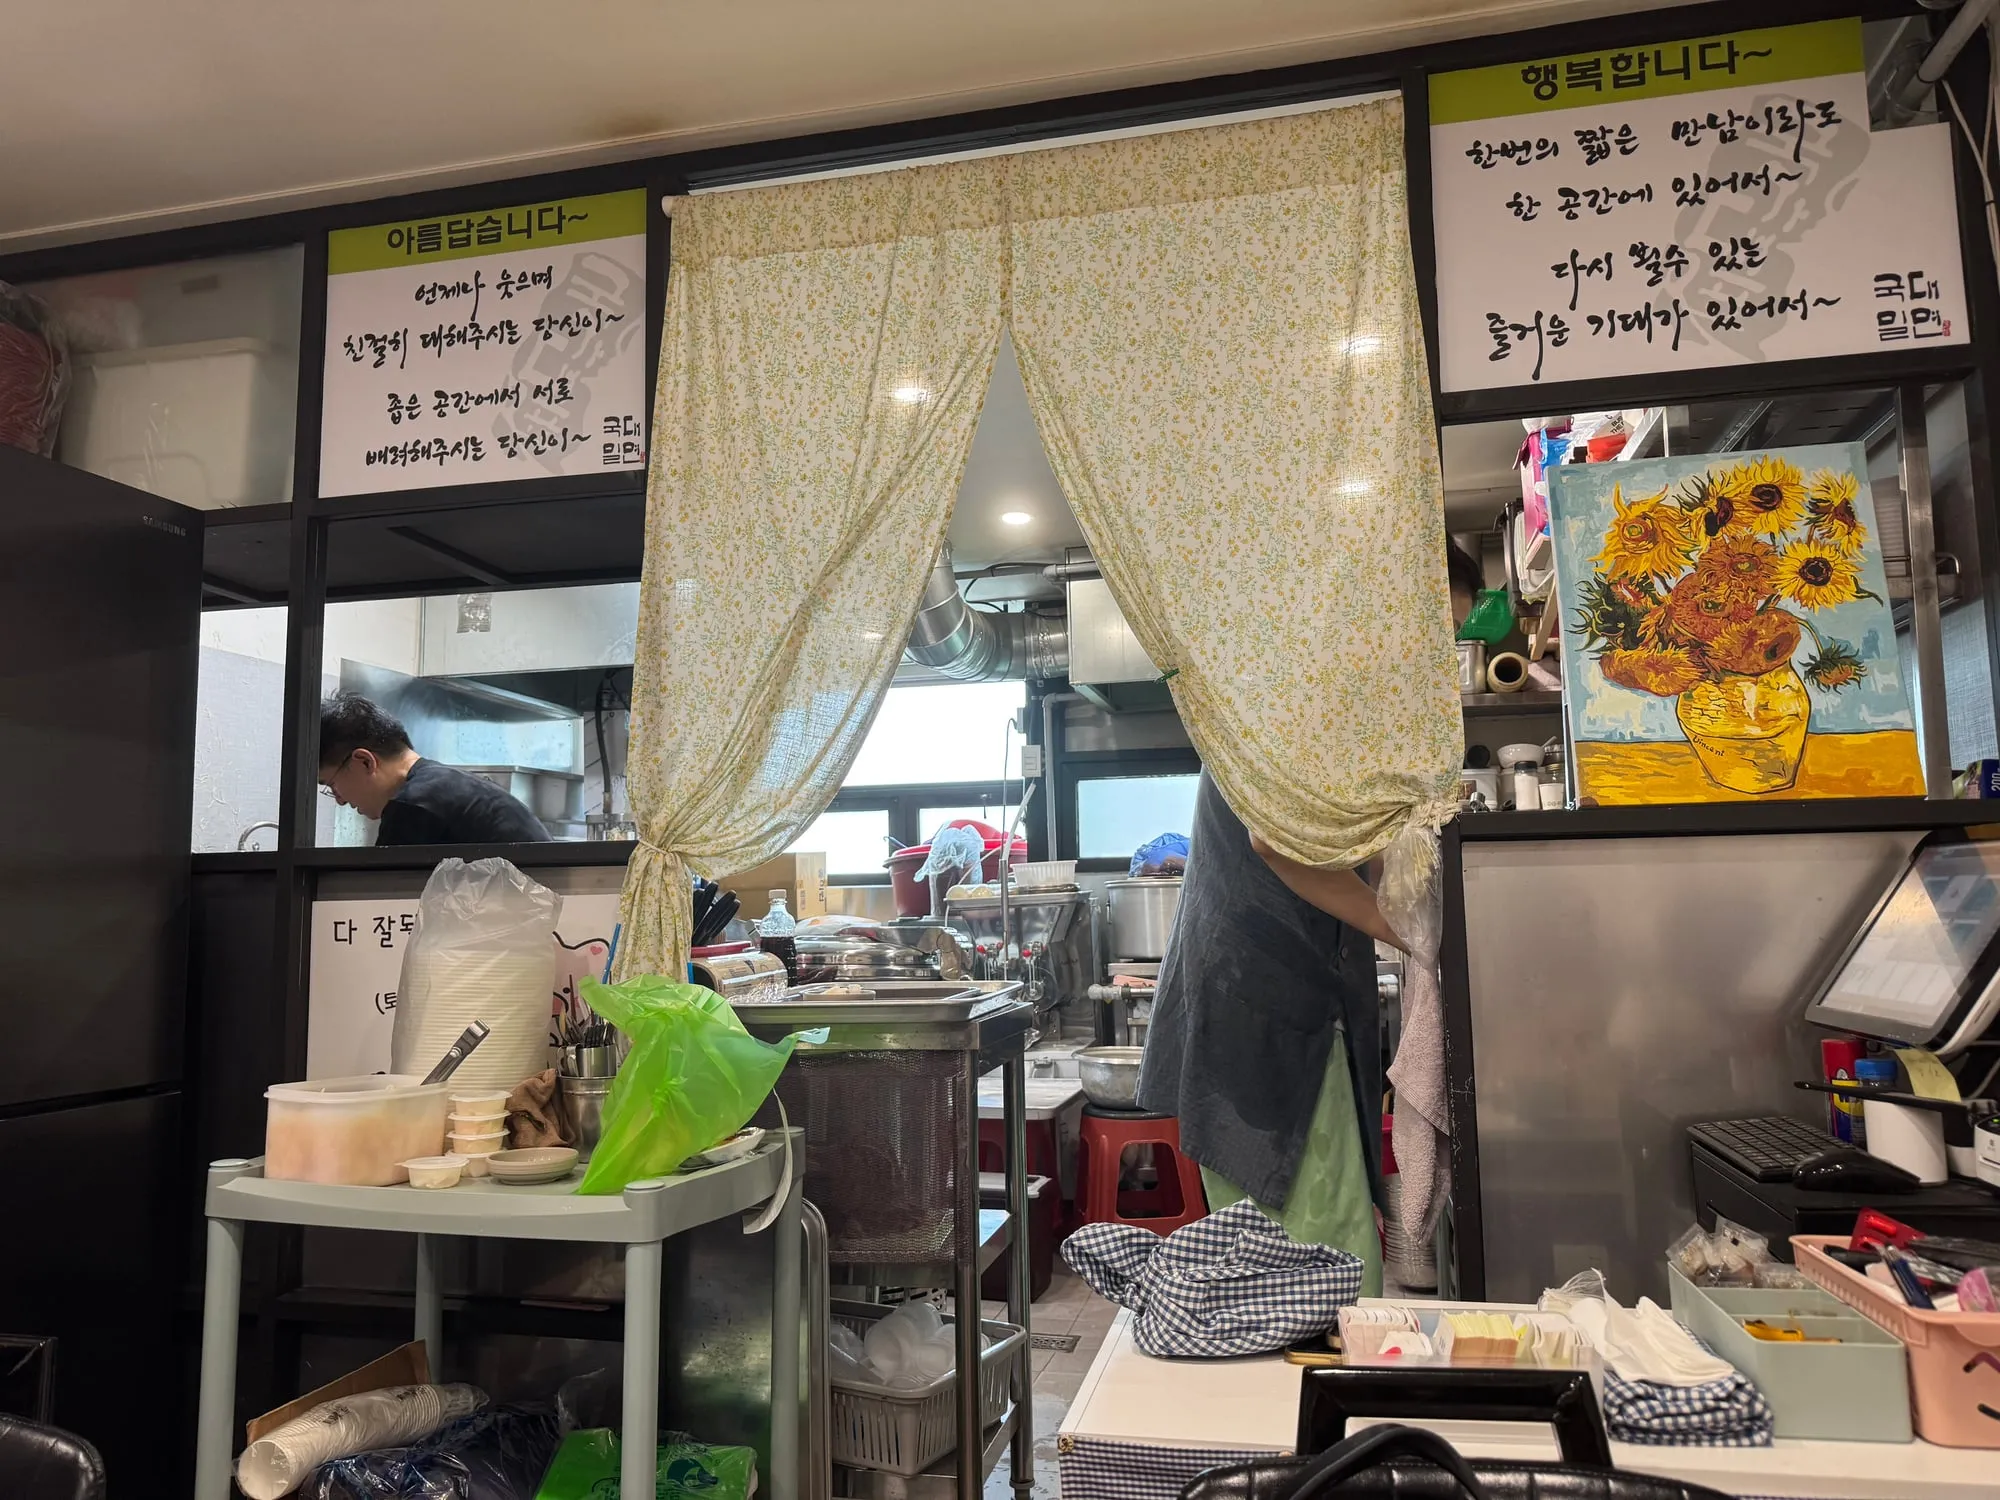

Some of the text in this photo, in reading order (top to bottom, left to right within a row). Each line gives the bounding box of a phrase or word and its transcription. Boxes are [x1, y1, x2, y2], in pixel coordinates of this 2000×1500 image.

[1521, 42, 1772, 100] 행복합니다~
[1466, 99, 1842, 169] 한번의 짧은 만남이라도
[1506, 165, 1802, 221] 한 공간에 있어서~
[388, 207, 588, 255] 아름답습니다~
[415, 266, 552, 321] 언제나 웃으며
[1551, 249, 1612, 310] 다시
[1709, 238, 1767, 271] 있는
[1874, 271, 1939, 301] 국대
[344, 309, 624, 369] 친절히 대해주시는 당신이~
[1486, 289, 1840, 381] 즐거운 기대가 있어서~
[1877, 308, 1942, 341] 밀면
[433, 383, 520, 417] 공간에서
[533, 378, 573, 404] 서로
[366, 428, 591, 466] 배려해주시는 당신이~
[604, 416, 640, 436] 국대
[603, 442, 642, 464] 밀면
[333, 919, 358, 945] 다
